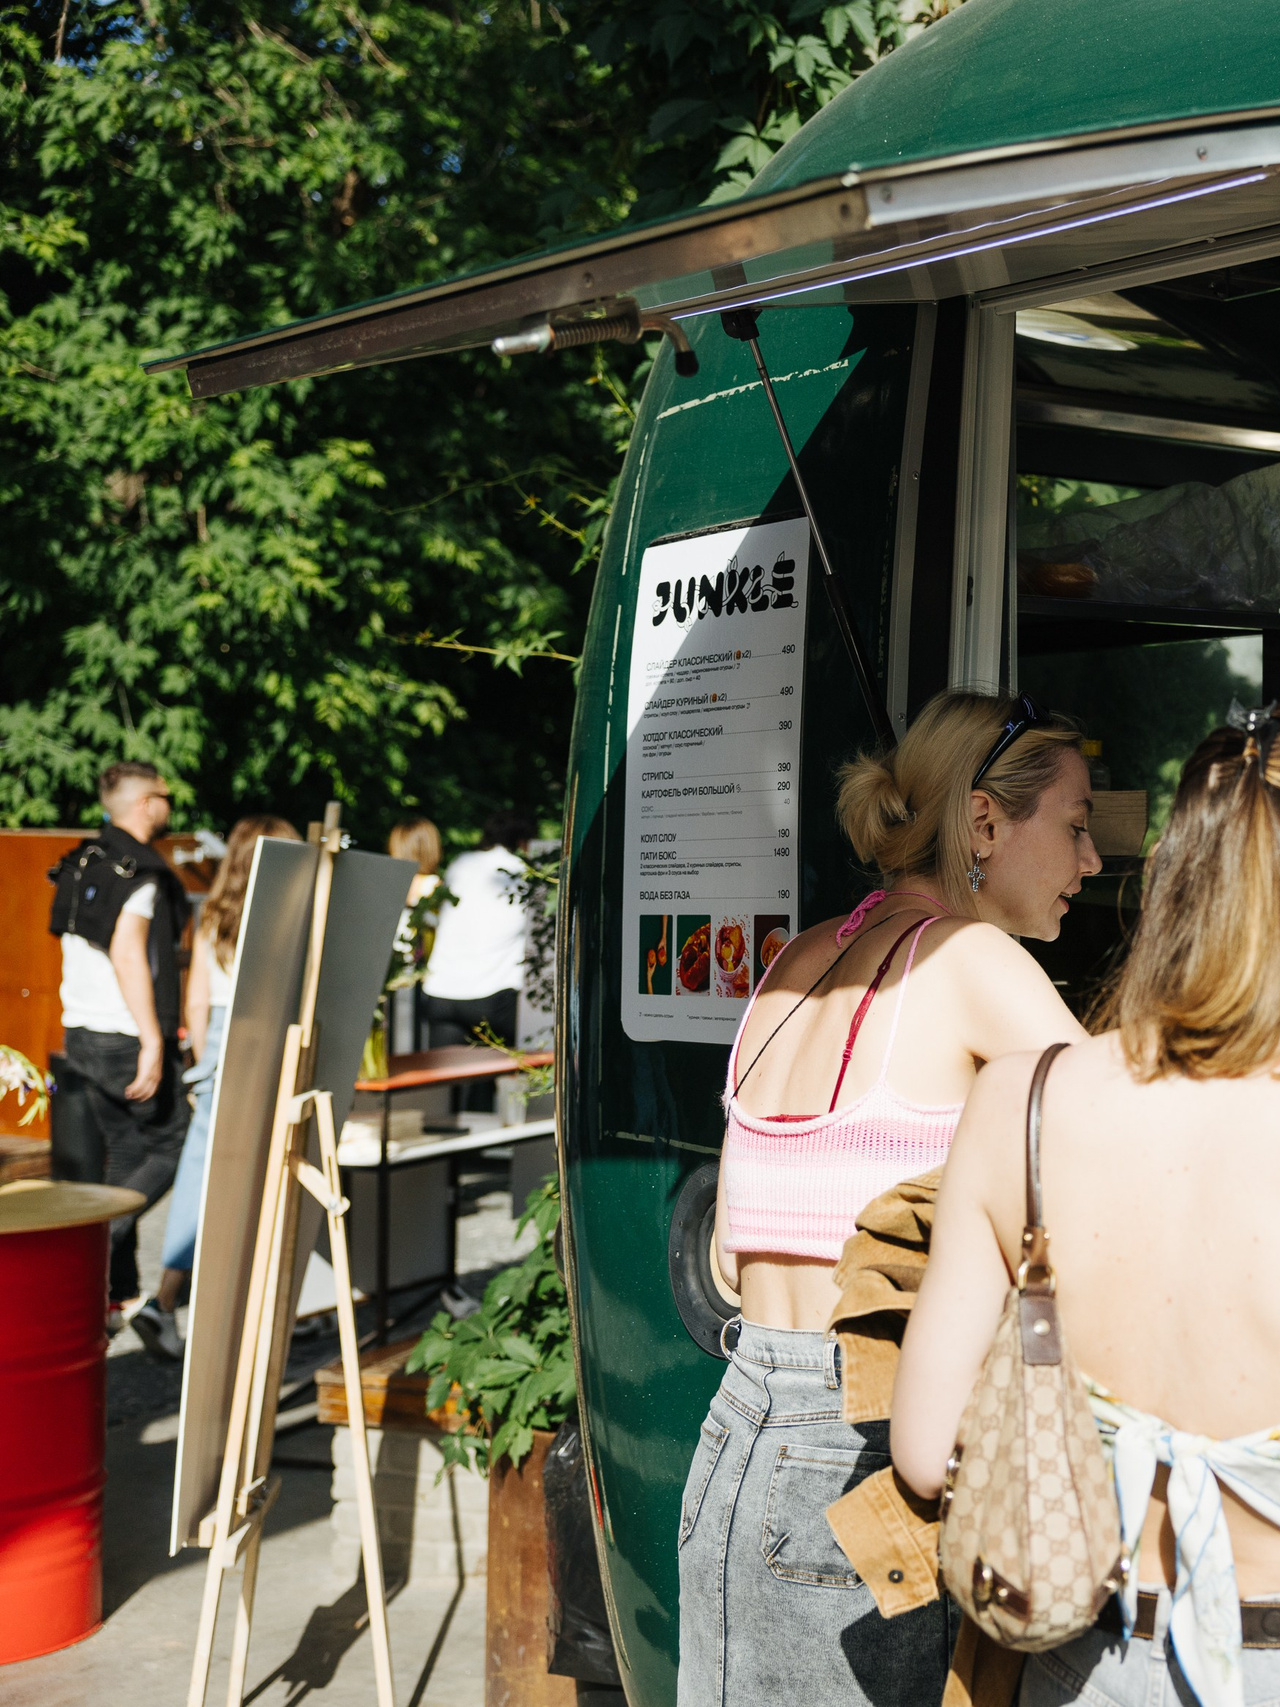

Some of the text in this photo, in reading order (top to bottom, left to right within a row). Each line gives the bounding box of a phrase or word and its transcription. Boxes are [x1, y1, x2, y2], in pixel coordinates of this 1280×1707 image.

[652, 555, 797, 628] JUNKLE
[678, 650, 732, 667] КЛАССИЧЕСКИЙ
[782, 644, 795, 654] 490
[645, 699, 675, 710] СЛАЙДЕР
[676, 694, 708, 707] КУРИНЫЙ
[780, 686, 793, 696] 490
[643, 720, 792, 742] ХОТДОГ КЛАССИЧЕСКИЙ 390
[642, 762, 791, 781] СТРИПСЫ 390
[642, 781, 790, 799] КАРТОФЕЛЬ ФРИ БОЛЬШОЙ 290
[641, 829, 790, 843] КОУЛ СЛОУ 190
[640, 848, 790, 861] ПАТИ БОКС 1490
[640, 890, 790, 901] ВОДА БЕЗ ГАЗА 190
